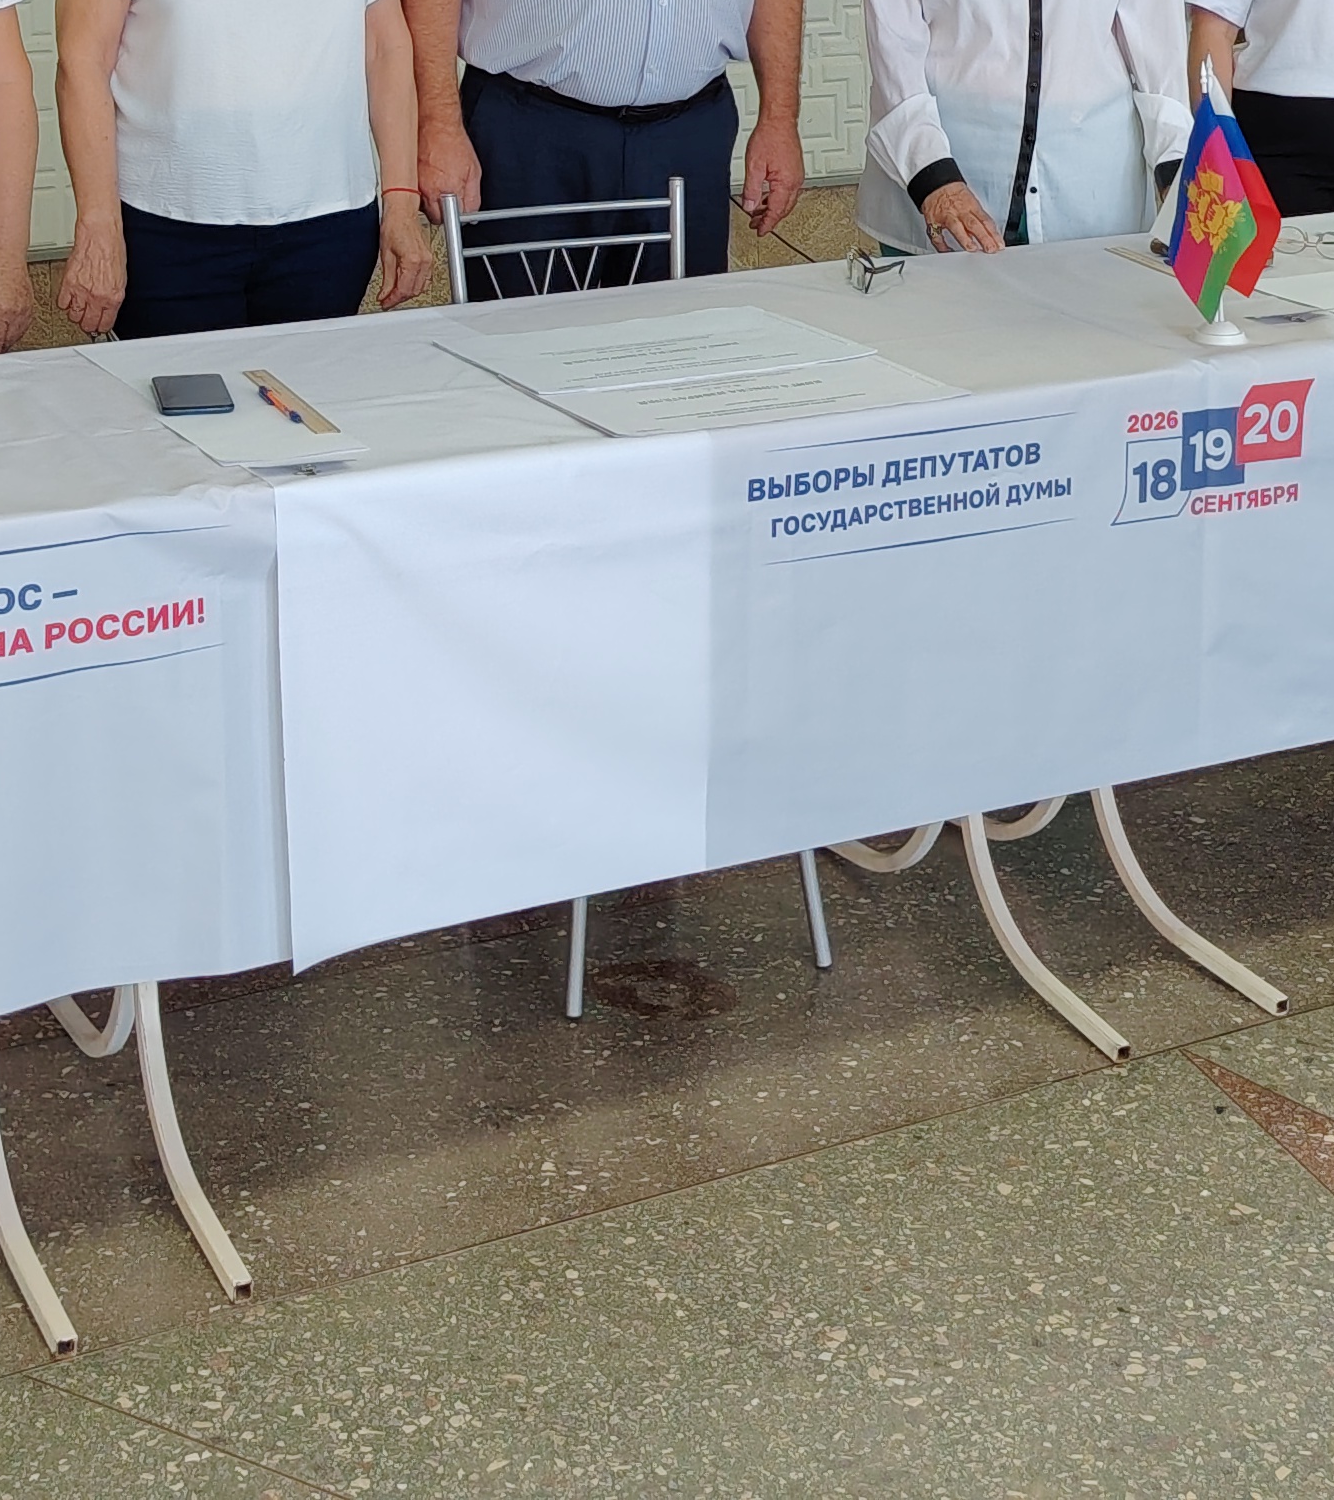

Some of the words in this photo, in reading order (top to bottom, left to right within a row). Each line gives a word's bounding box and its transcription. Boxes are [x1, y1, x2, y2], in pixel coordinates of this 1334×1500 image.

[1127, 410, 1179, 433] 2026
[747, 463, 875, 503] ВЫБОРЫ
[881, 442, 1041, 488] ДЕПУТАТОВ
[1132, 458, 1177, 504] 18
[1189, 428, 1233, 474] 19
[1242, 400, 1299, 445] 20
[771, 482, 1000, 538] ГОСУДАРСТВЕННОЙ
[1005, 477, 1072, 508] ДУМЫ
[1190, 483, 1299, 515] СЕНТЯБРЯ
[43, 597, 206, 650] РОССИИ!
